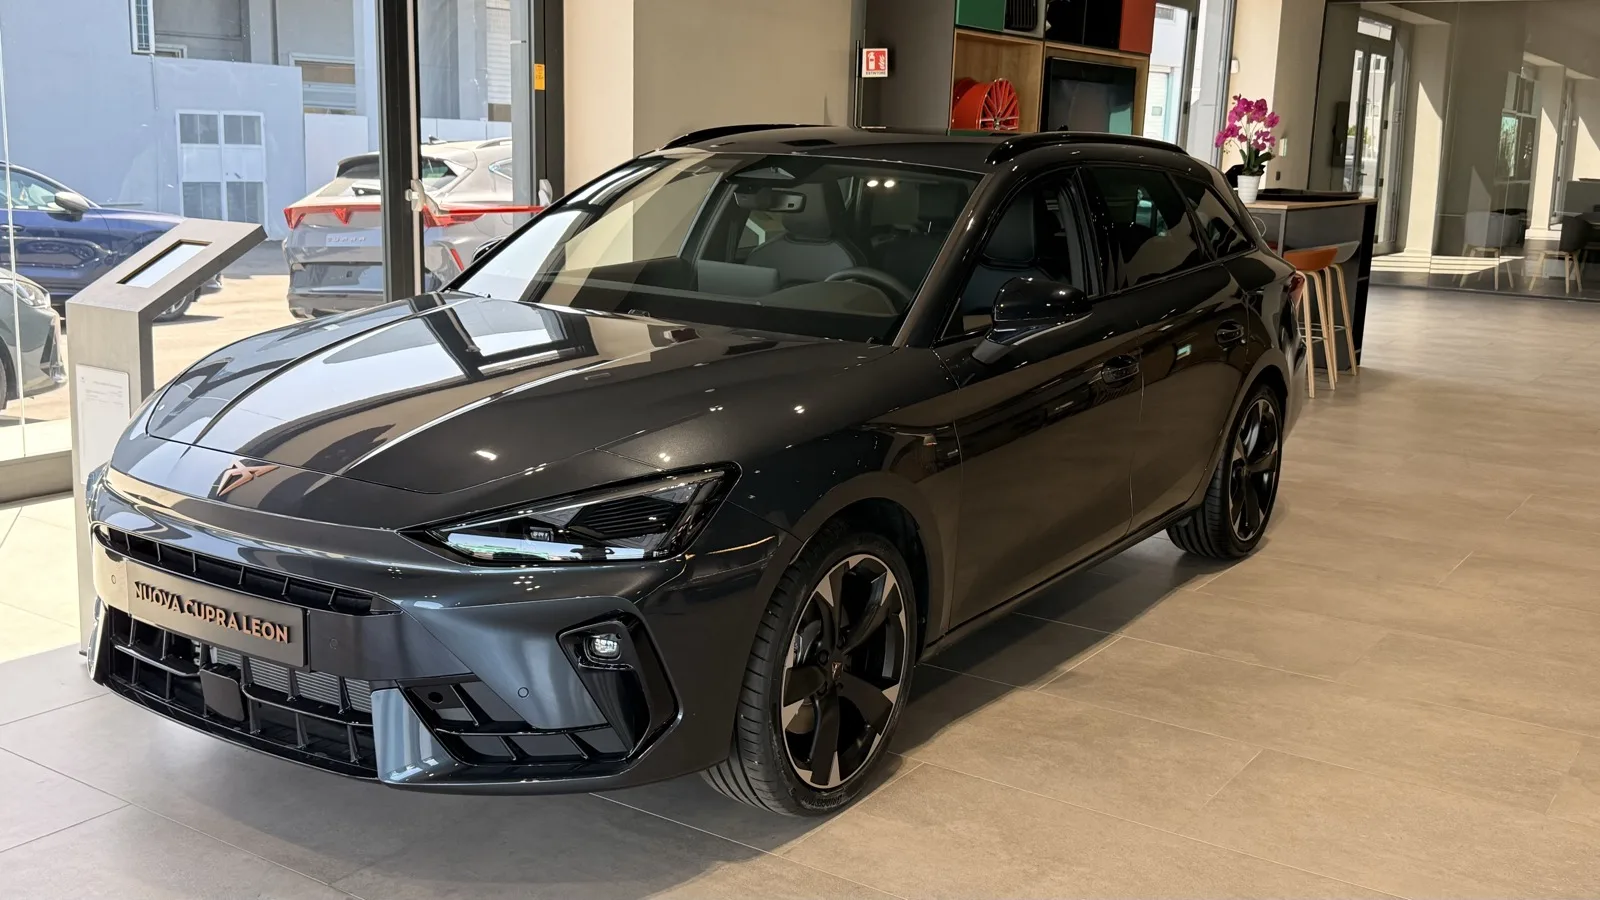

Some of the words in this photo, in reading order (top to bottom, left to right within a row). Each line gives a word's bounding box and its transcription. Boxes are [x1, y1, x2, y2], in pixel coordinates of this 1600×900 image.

[135, 581, 183, 614] NUOVA
[183, 599, 240, 632] CUPRA
[243, 614, 290, 644] LEON
